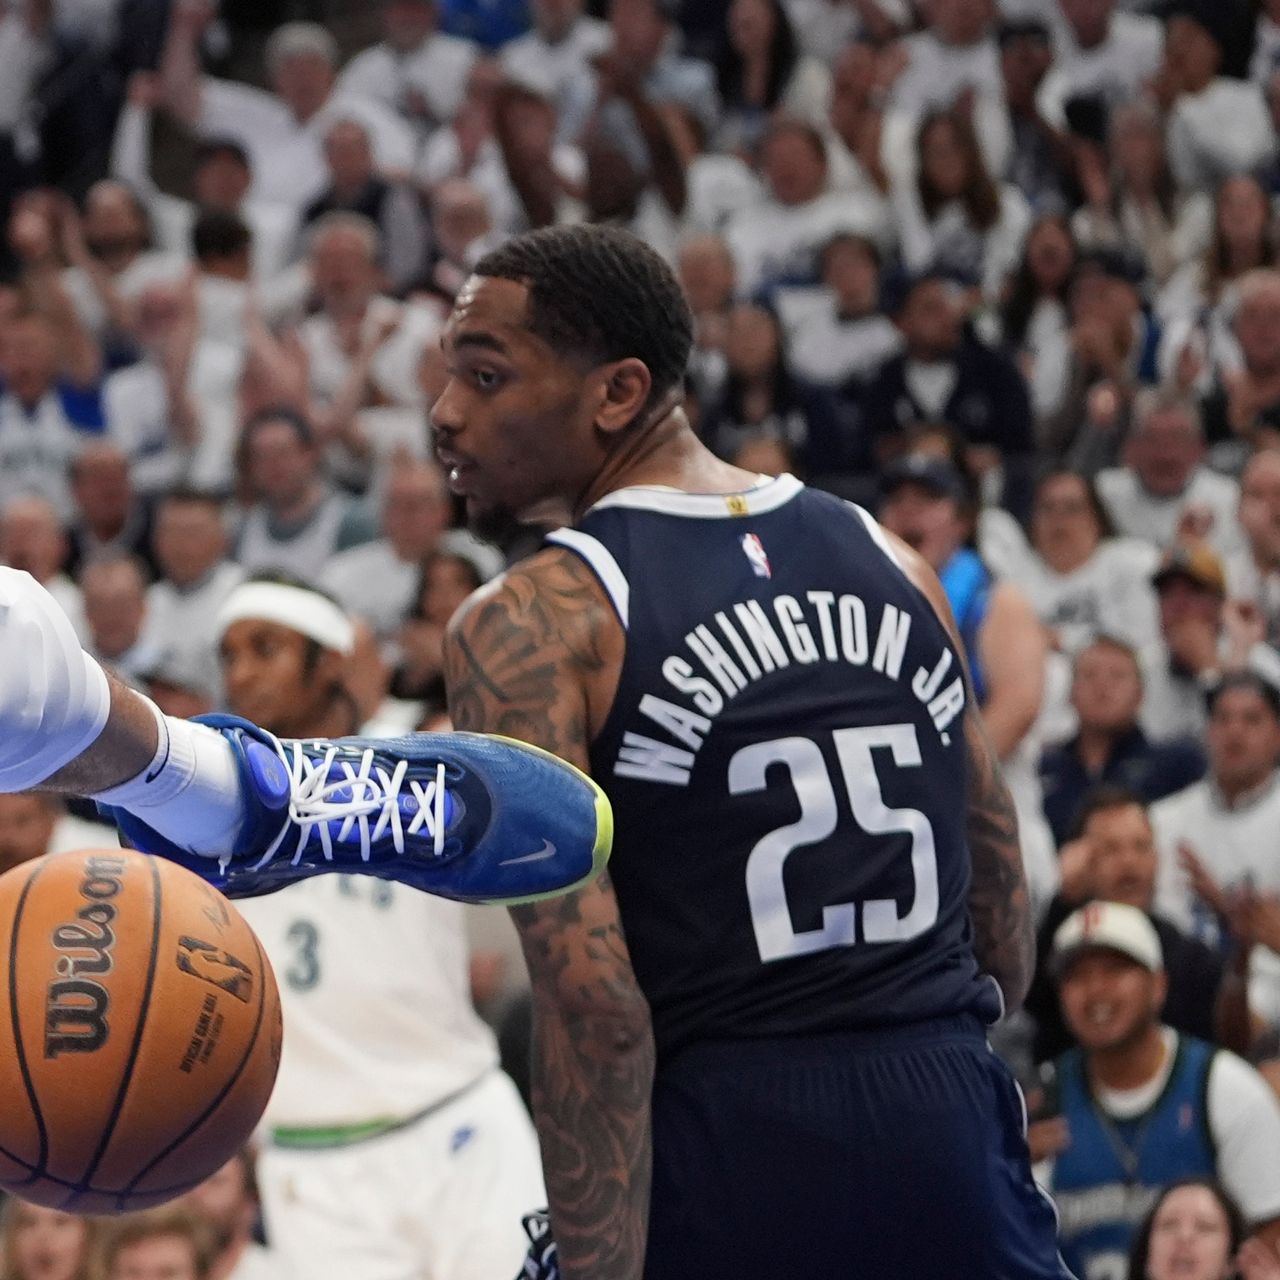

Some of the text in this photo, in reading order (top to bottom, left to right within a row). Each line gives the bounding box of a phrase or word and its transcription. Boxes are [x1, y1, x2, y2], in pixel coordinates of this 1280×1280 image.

[614, 591, 965, 787] WASHINGTON JR.
[728, 722, 940, 964] 25
[44, 856, 128, 1060] Wilson
[285, 918, 321, 992] 3
